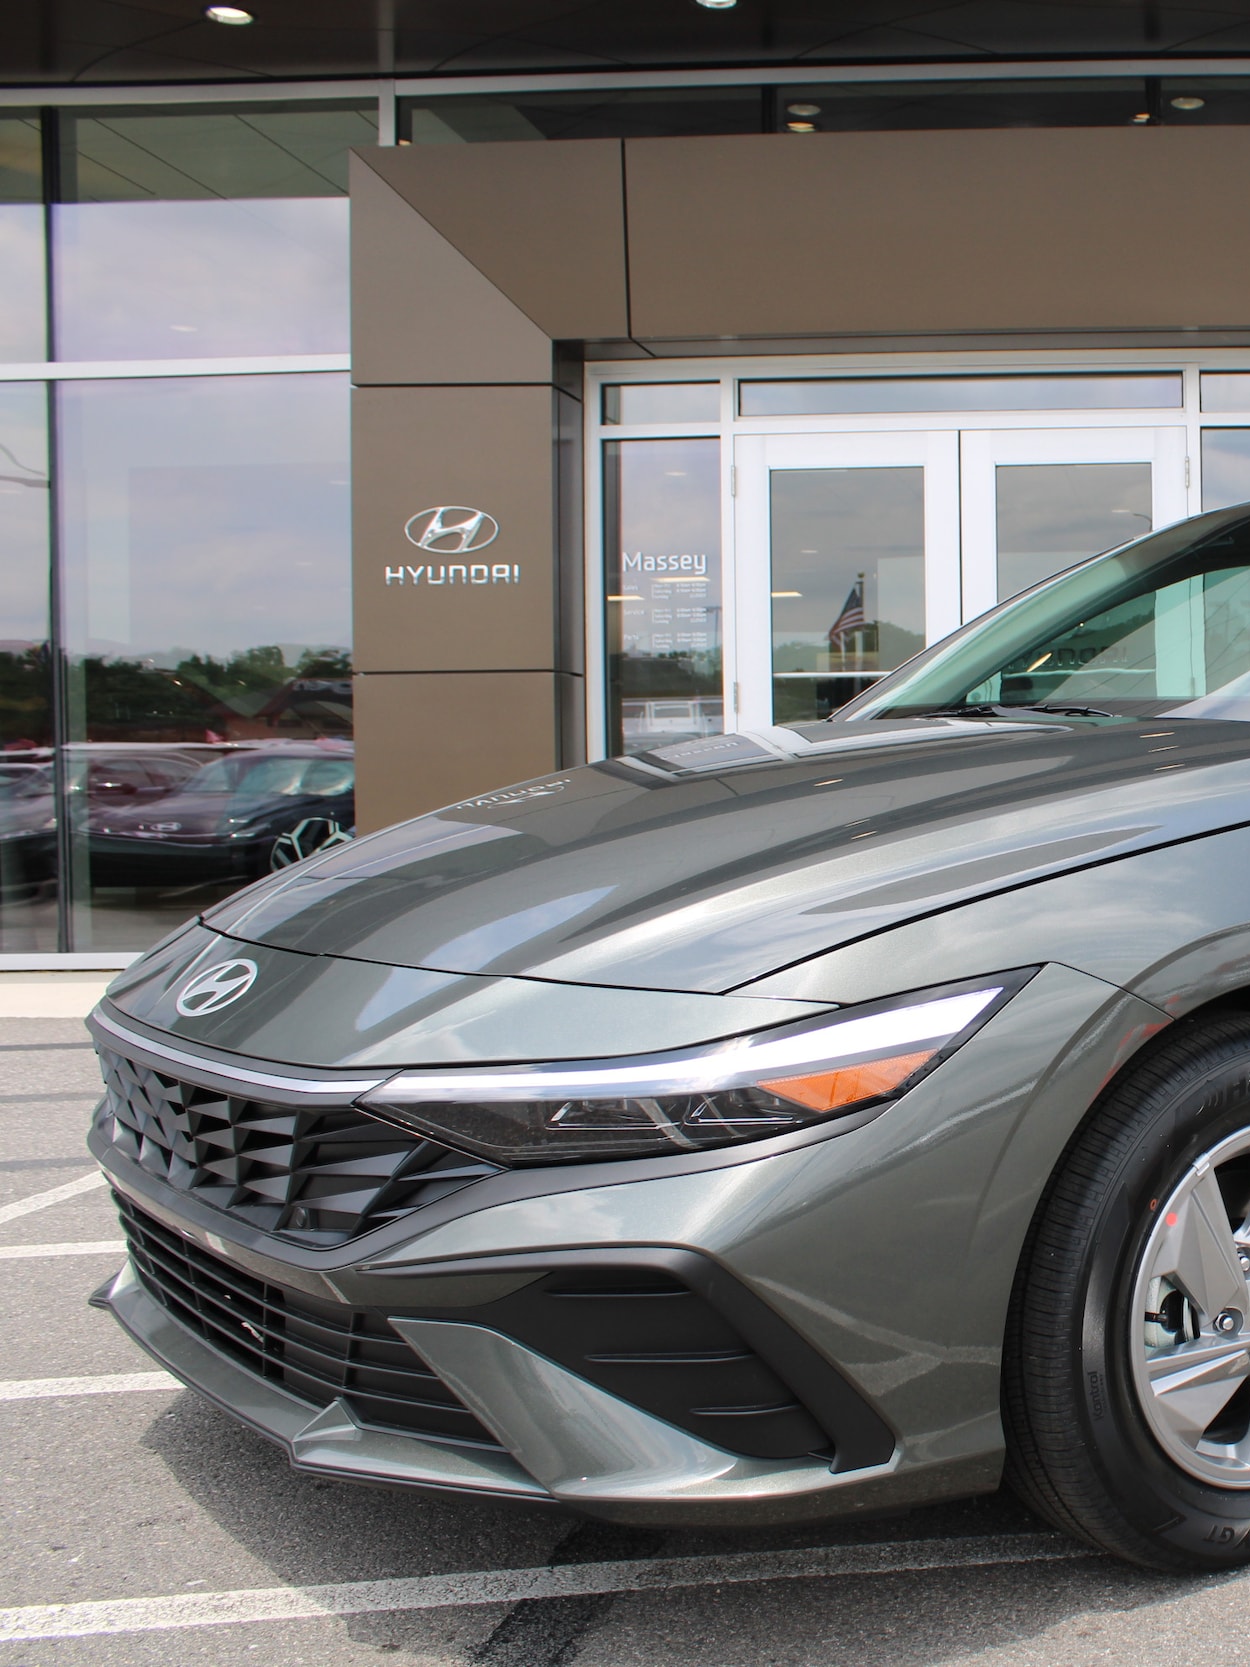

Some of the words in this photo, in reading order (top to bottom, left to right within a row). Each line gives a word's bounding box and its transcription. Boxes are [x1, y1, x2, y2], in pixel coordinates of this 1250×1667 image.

[622, 551, 707, 576] Massey
[385, 564, 520, 585] HYUNDAI
[1202, 1524, 1236, 1545] GT
